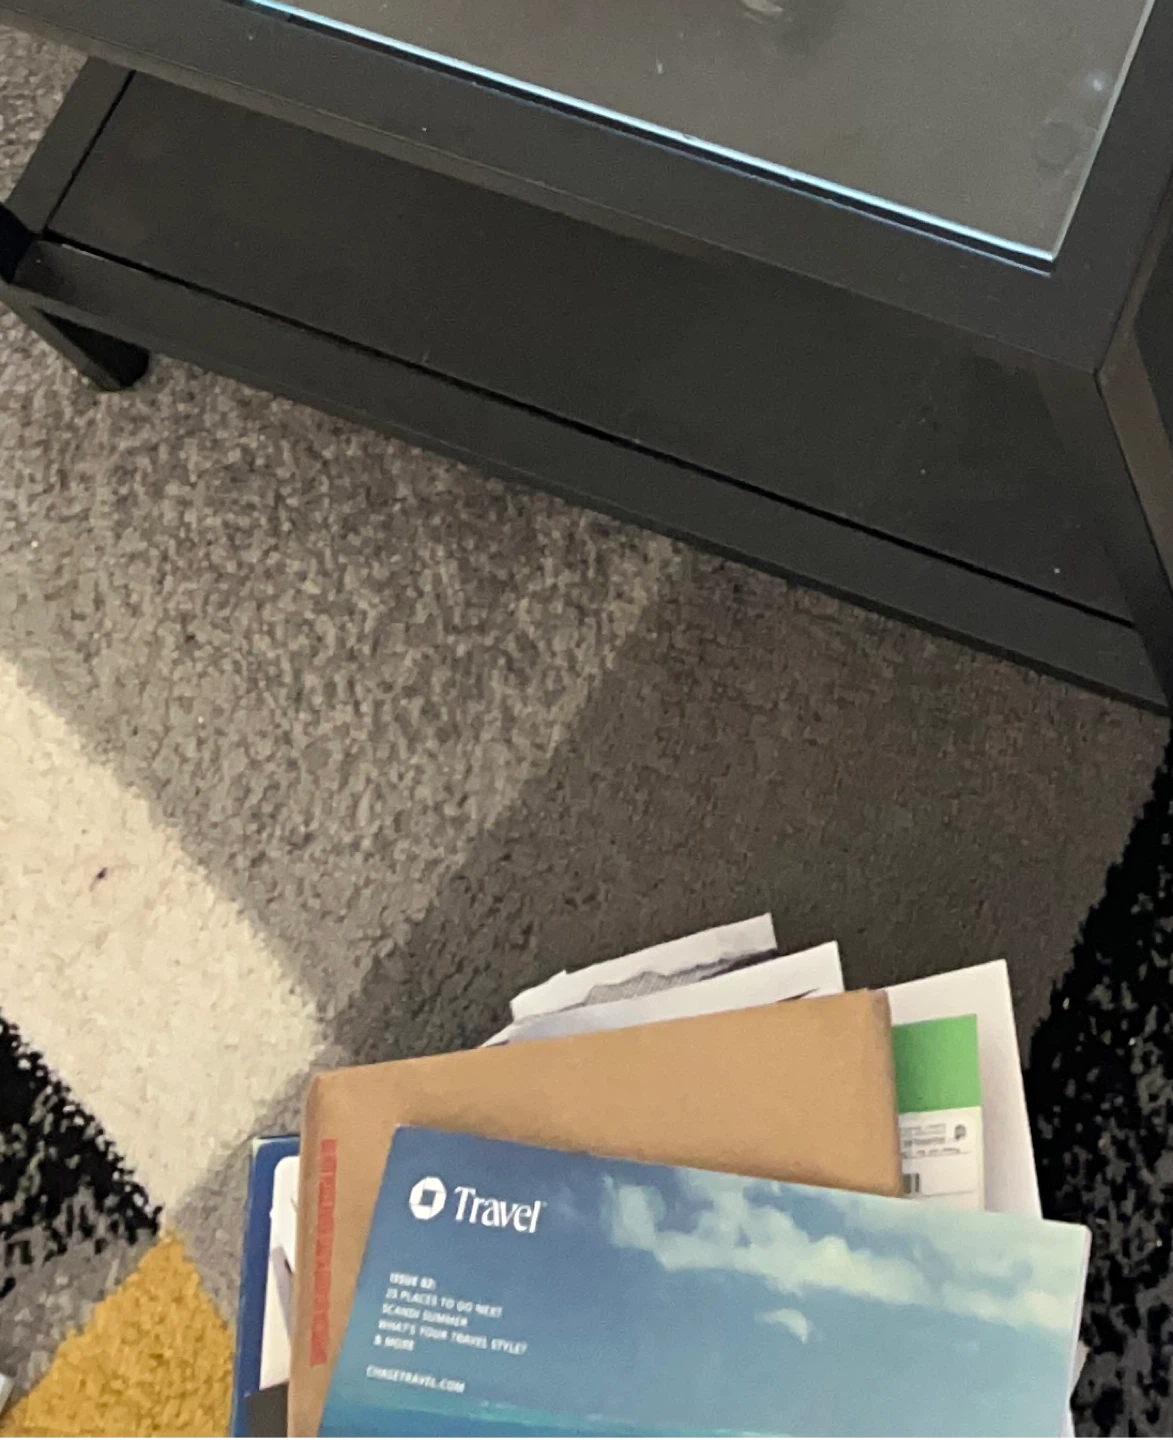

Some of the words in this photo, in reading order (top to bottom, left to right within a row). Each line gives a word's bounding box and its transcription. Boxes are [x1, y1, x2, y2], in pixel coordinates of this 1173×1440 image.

[453, 1185, 543, 1234] Travel
[390, 1272, 419, 1287] ISSUE
[400, 1290, 438, 1306] PLACES
[441, 1297, 456, 1310] TO
[456, 1300, 474, 1313] GO
[475, 1304, 503, 1318] NEXT
[422, 1309, 469, 1327] SUMMER
[384, 1336, 415, 1352] MORE
[419, 1326, 448, 1340] YOUR
[451, 1331, 488, 1349] TRAVEL
[491, 1338, 528, 1355] STYLE?
[366, 1365, 466, 1393] CHASETRAVEL.COM
